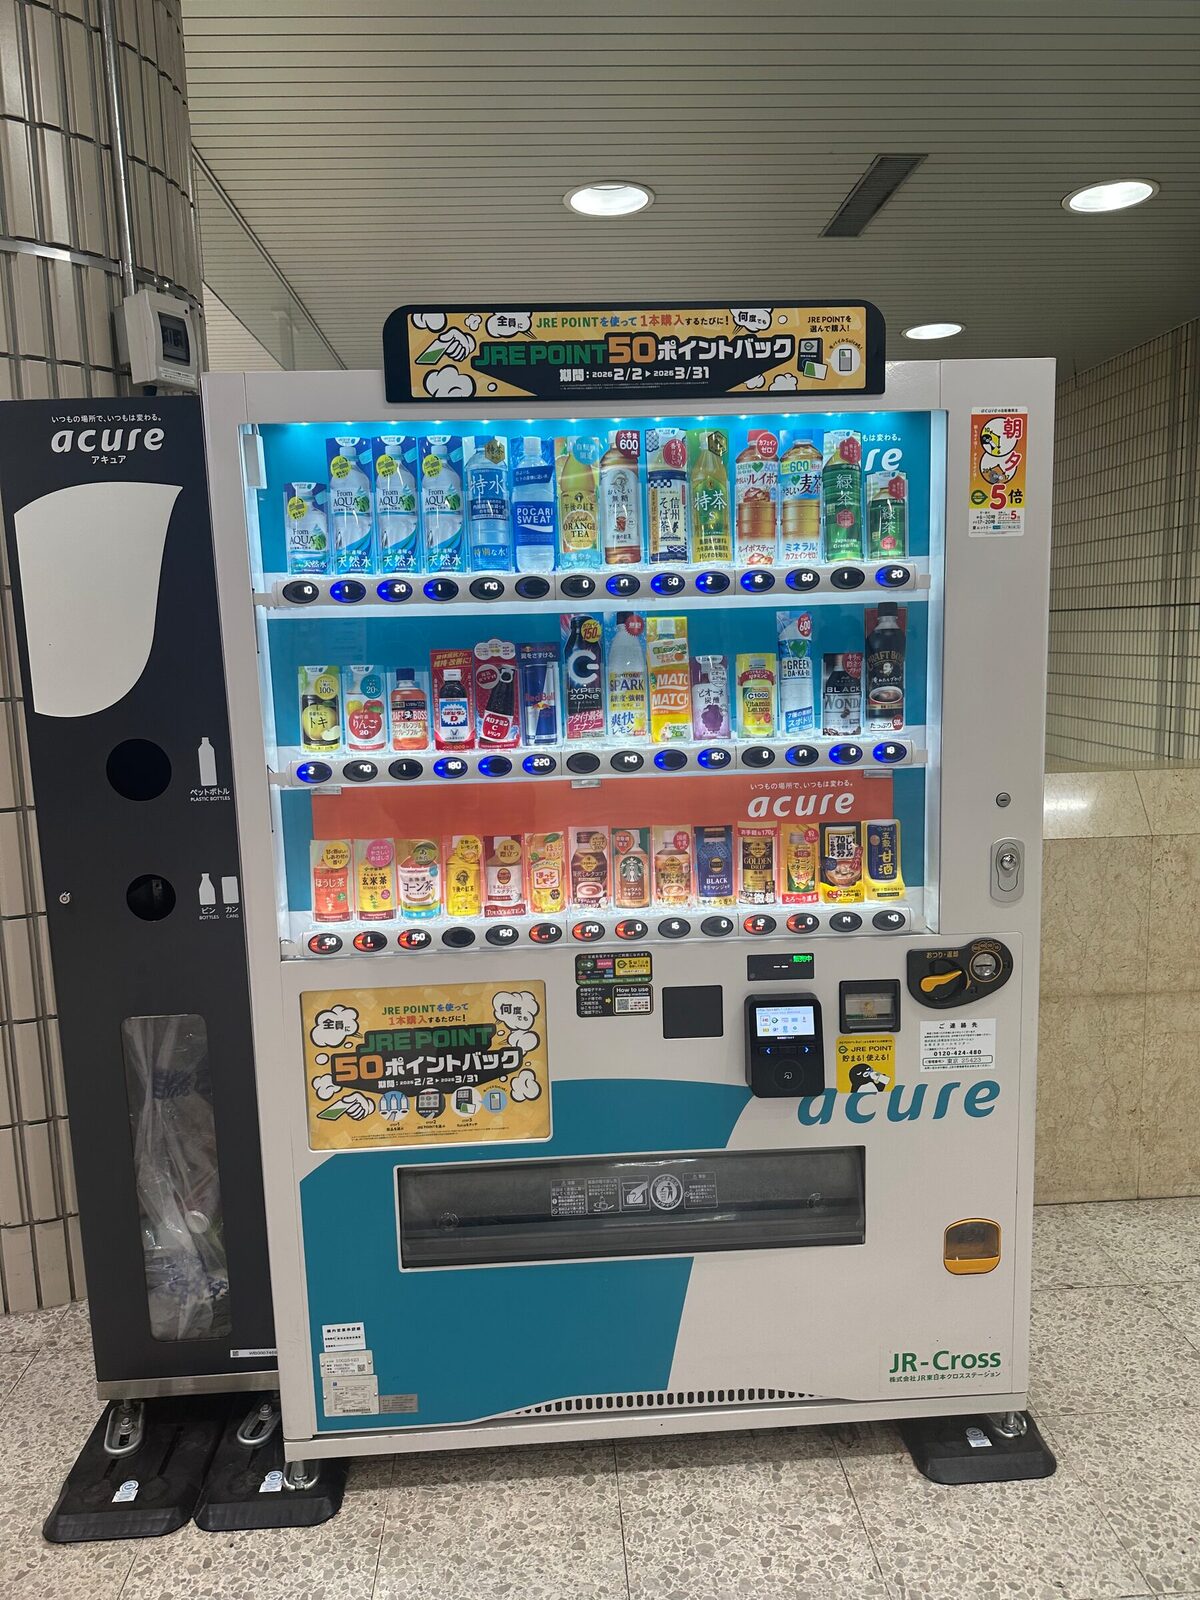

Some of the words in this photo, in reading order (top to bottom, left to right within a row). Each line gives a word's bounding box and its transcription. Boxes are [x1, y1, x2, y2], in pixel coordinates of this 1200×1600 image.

[497, 316, 523, 329] 全員に
[536, 317, 558, 328] JRE
[738, 311, 767, 325] 何度でも
[807, 315, 821, 323] JRE
[822, 315, 851, 323] POINTを
[475, 345, 526, 366] JRE
[613, 368, 642, 381] 2/2
[674, 366, 710, 380] 3/31
[51, 414, 162, 424] いつもの場所で、いつもは変わる。
[1003, 418, 1022, 439] 朝
[51, 427, 165, 453] acure
[620, 440, 639, 450] 600
[91, 455, 127, 464] アキュア
[1005, 452, 1021, 472] 夕
[790, 460, 809, 472] 600
[470, 474, 506, 495] 特水
[695, 490, 727, 511] 特茶
[517, 507, 553, 516] POCARI
[517, 516, 551, 524] SWEAT
[563, 521, 596, 531] ORANGE
[610, 679, 644, 692] SPARK
[310, 717, 328, 728] トキ
[353, 719, 378, 729] りんご
[750, 780, 854, 791] いつもの場所で、いつもは変わる。
[190, 788, 230, 797] ペットボトル
[747, 792, 855, 819] acure
[315, 877, 345, 887] ほうじ茶
[362, 876, 387, 886] 玄米茶
[201, 906, 216, 915] ビン
[225, 906, 239, 914] カン
[382, 1006, 402, 1016] JRE
[322, 1018, 350, 1032] 全員に
[359, 1031, 412, 1053] JRE
[416, 1027, 493, 1049] POINT
[414, 1076, 434, 1086] 2/2
[454, 1075, 479, 1084] 3/31
[797, 1080, 1001, 1126] acure
[889, 1350, 1002, 1374] JR-Cross
